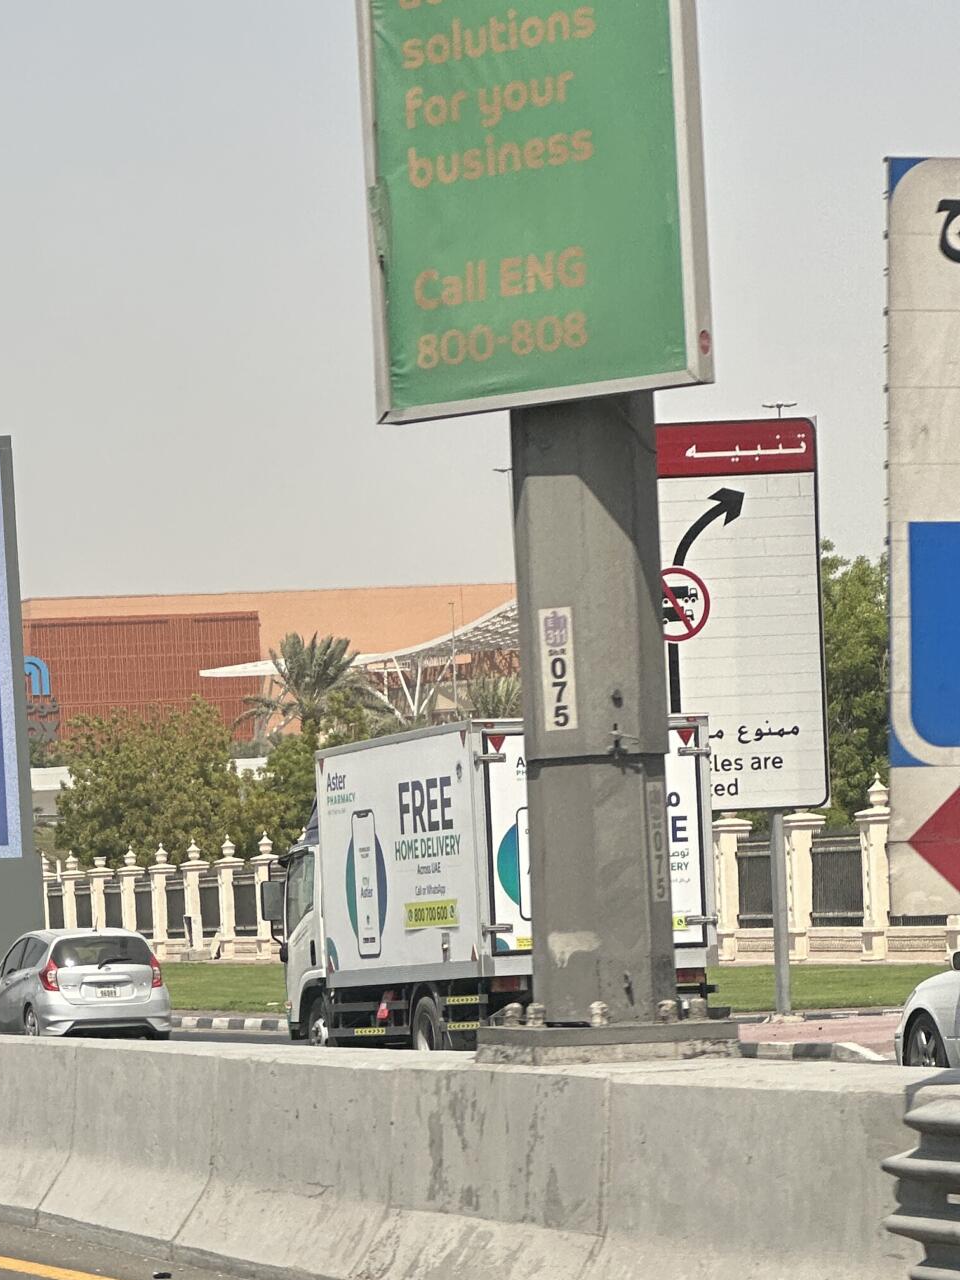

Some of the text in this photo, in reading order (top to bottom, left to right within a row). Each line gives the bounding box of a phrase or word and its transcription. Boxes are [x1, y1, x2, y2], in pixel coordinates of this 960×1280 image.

[402, 6, 596, 70] solutions
[405, 70, 575, 129] for your
[407, 129, 594, 189] business
[414, 245, 587, 311] Call ENG
[417, 311, 588, 369] 800-808
[685, 433, 806, 463] تنبيه
[737, 720, 800, 744] ممنوع
[750, 755, 784, 771] are
[326, 772, 346, 792] Aster
[398, 776, 454, 835] FREE
[394, 834, 461, 862] HOME DELIVERY
[417, 861, 441, 875] Across UAE
[414, 905, 448, 922] 800 700 600
